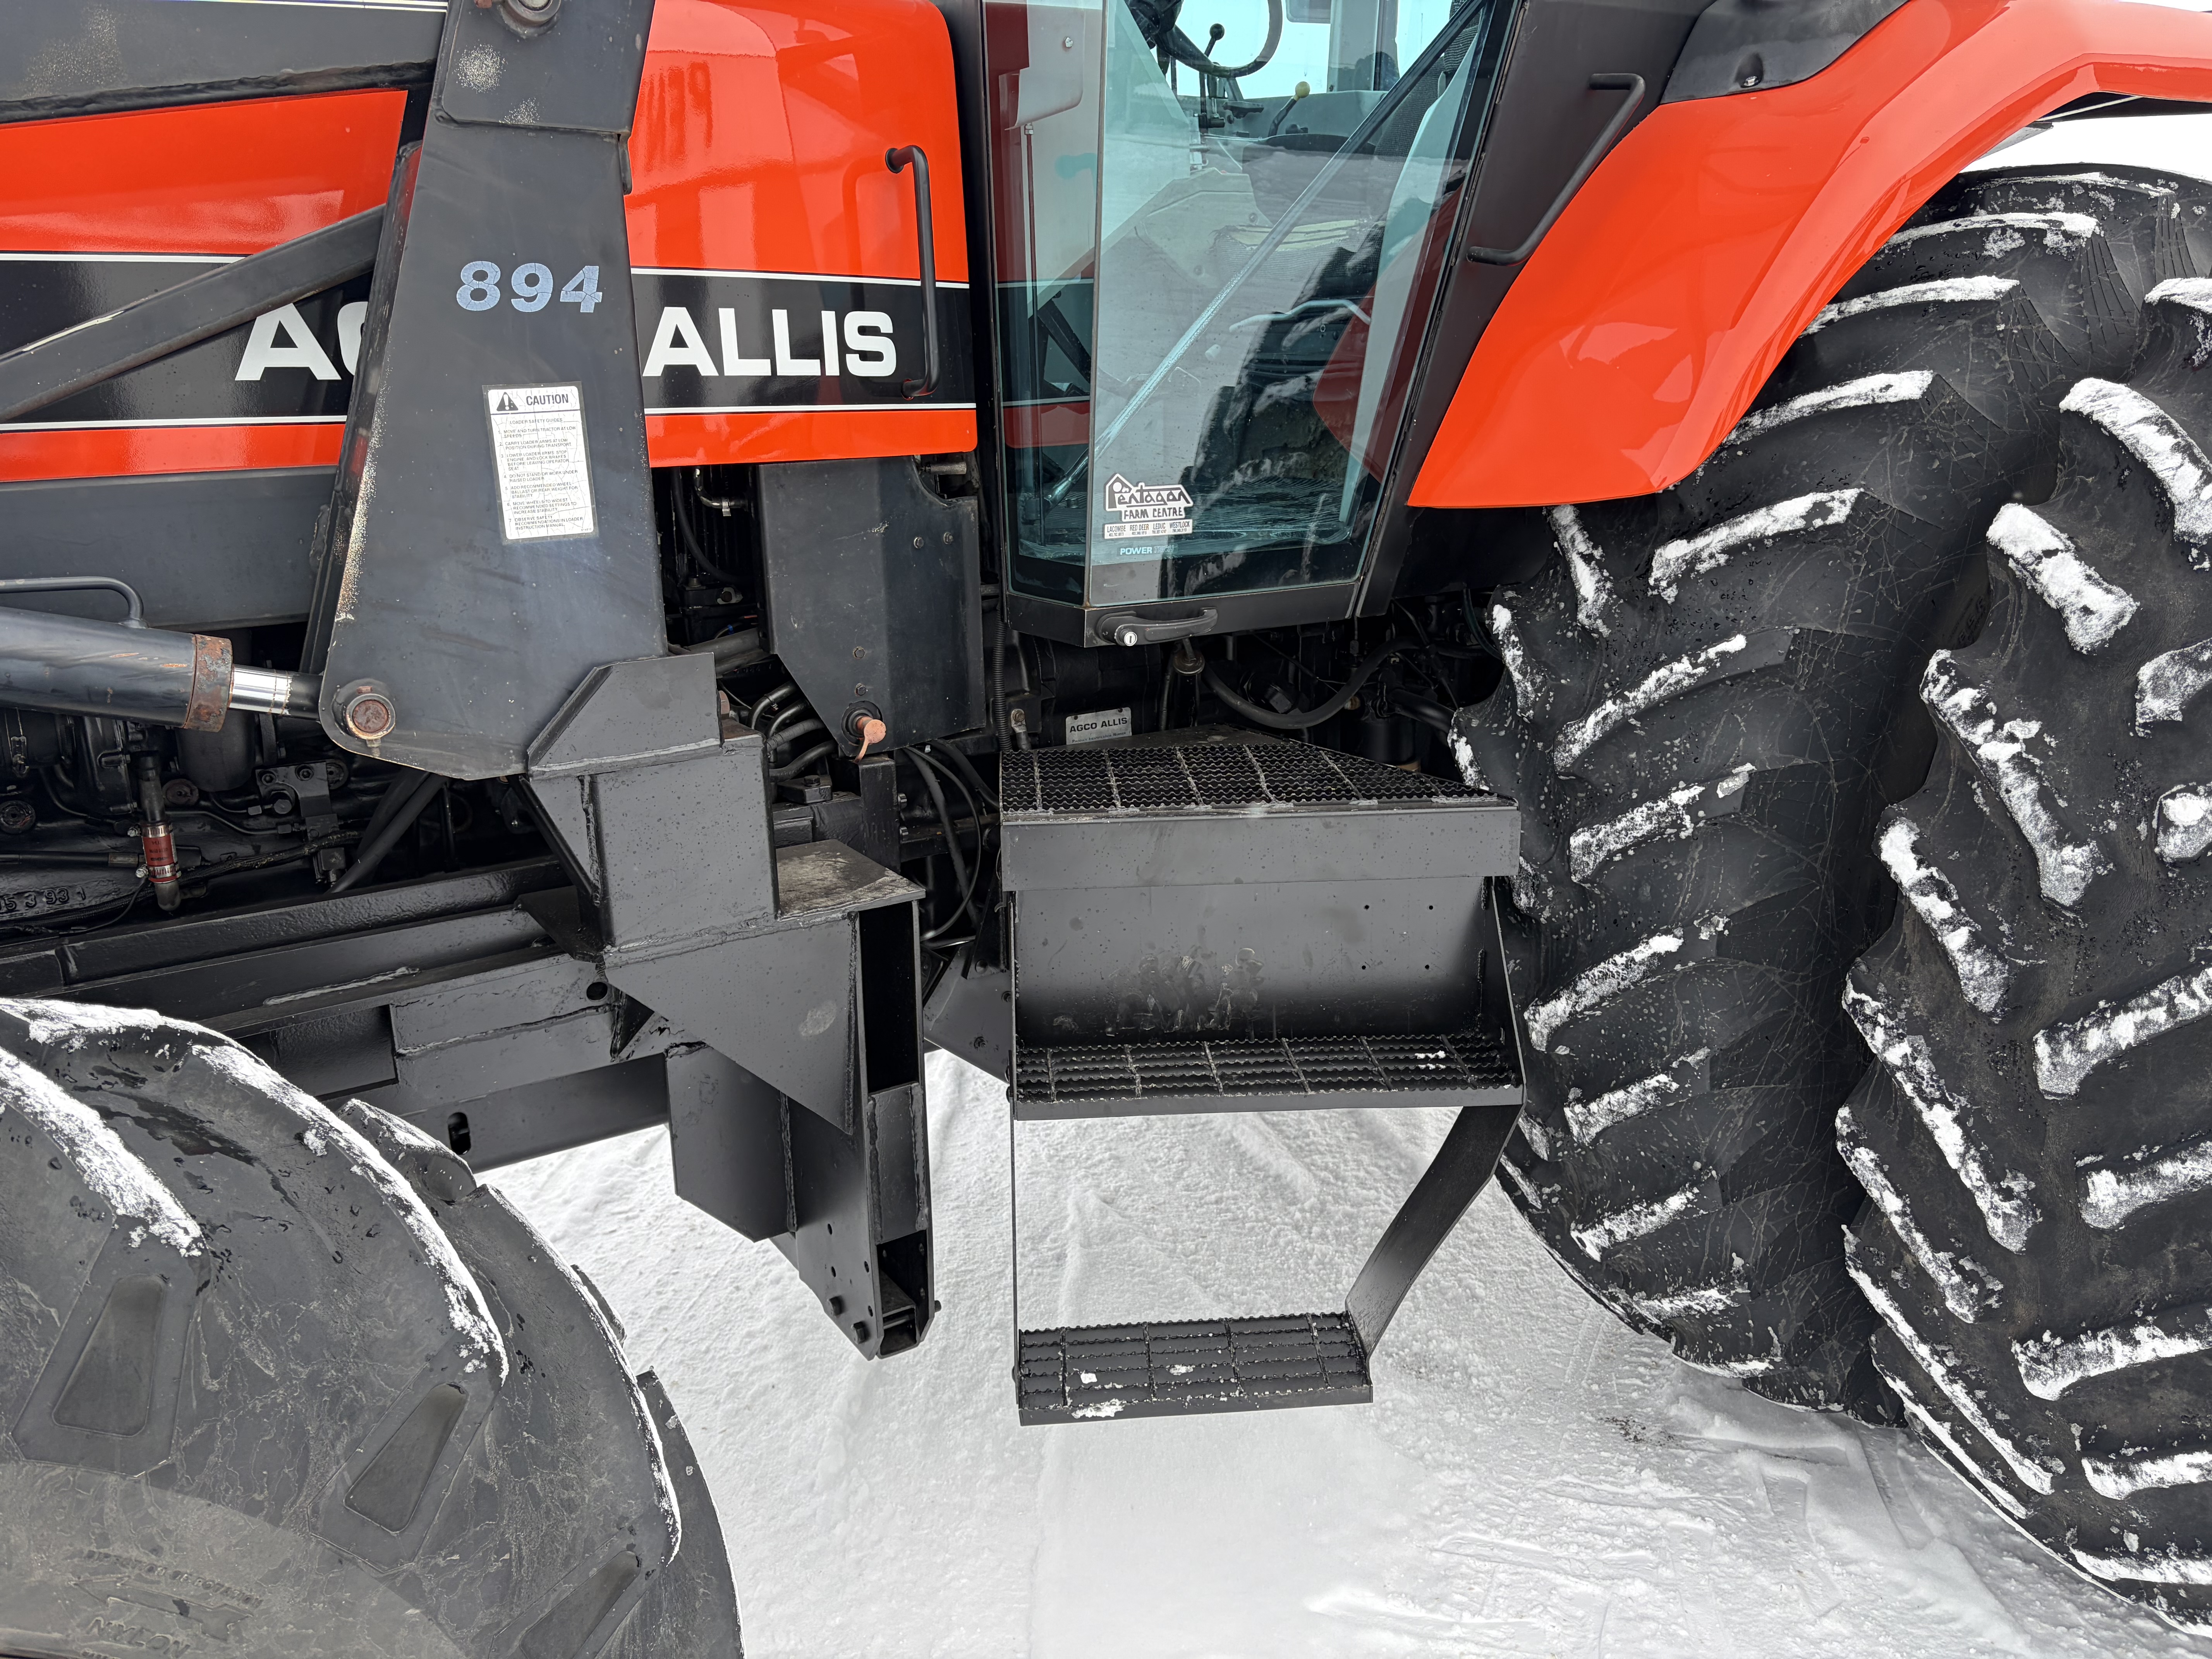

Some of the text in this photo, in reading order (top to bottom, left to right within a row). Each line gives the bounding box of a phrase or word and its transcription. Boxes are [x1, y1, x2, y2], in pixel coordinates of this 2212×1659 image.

[456, 260, 603, 313] 894
[642, 306, 897, 377] ALLIS
[526, 394, 568, 405] CAUTION
[1124, 507, 1183, 519] FARM CENTRE
[1154, 545, 1175, 553] TECH
[1070, 718, 1127, 733] AGCO ALLIS
